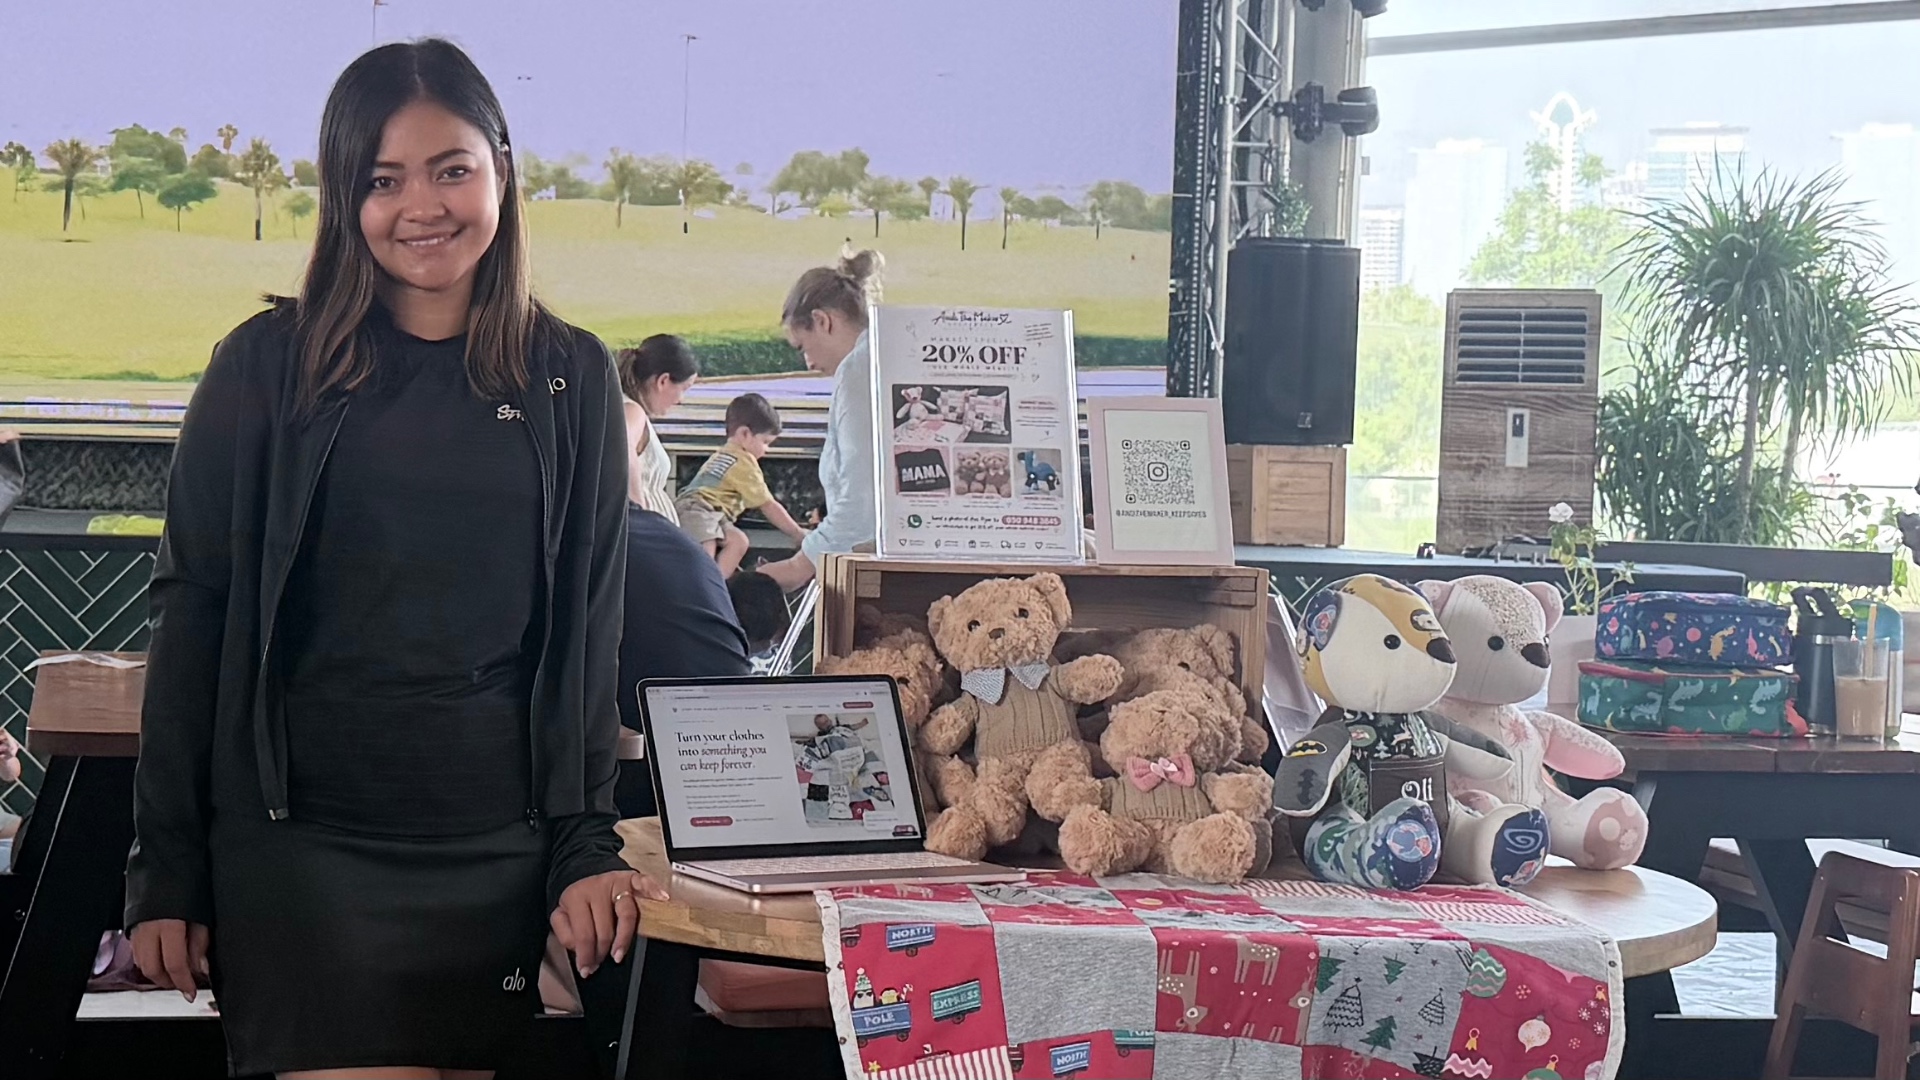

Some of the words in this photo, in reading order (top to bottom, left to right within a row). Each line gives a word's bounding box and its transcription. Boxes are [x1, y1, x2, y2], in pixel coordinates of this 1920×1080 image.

[922, 344, 974, 364] 20%
[979, 345, 1027, 364] OFF
[902, 464, 946, 482] MAMA
[674, 732, 701, 742] Turn
[702, 733, 727, 745] your
[729, 729, 765, 741] clothes
[678, 747, 699, 756] into
[701, 743, 748, 758] something
[749, 747, 767, 758] you
[680, 763, 697, 771] can
[699, 758, 719, 773] keep
[721, 757, 756, 773] forever.
[1401, 776, 1434, 800] Oli
[891, 926, 931, 940] NORTH
[502, 967, 526, 991] alo
[933, 989, 979, 1010] EXPRESS
[864, 1012, 896, 1027] POLE
[1056, 1050, 1088, 1066] NORTH
